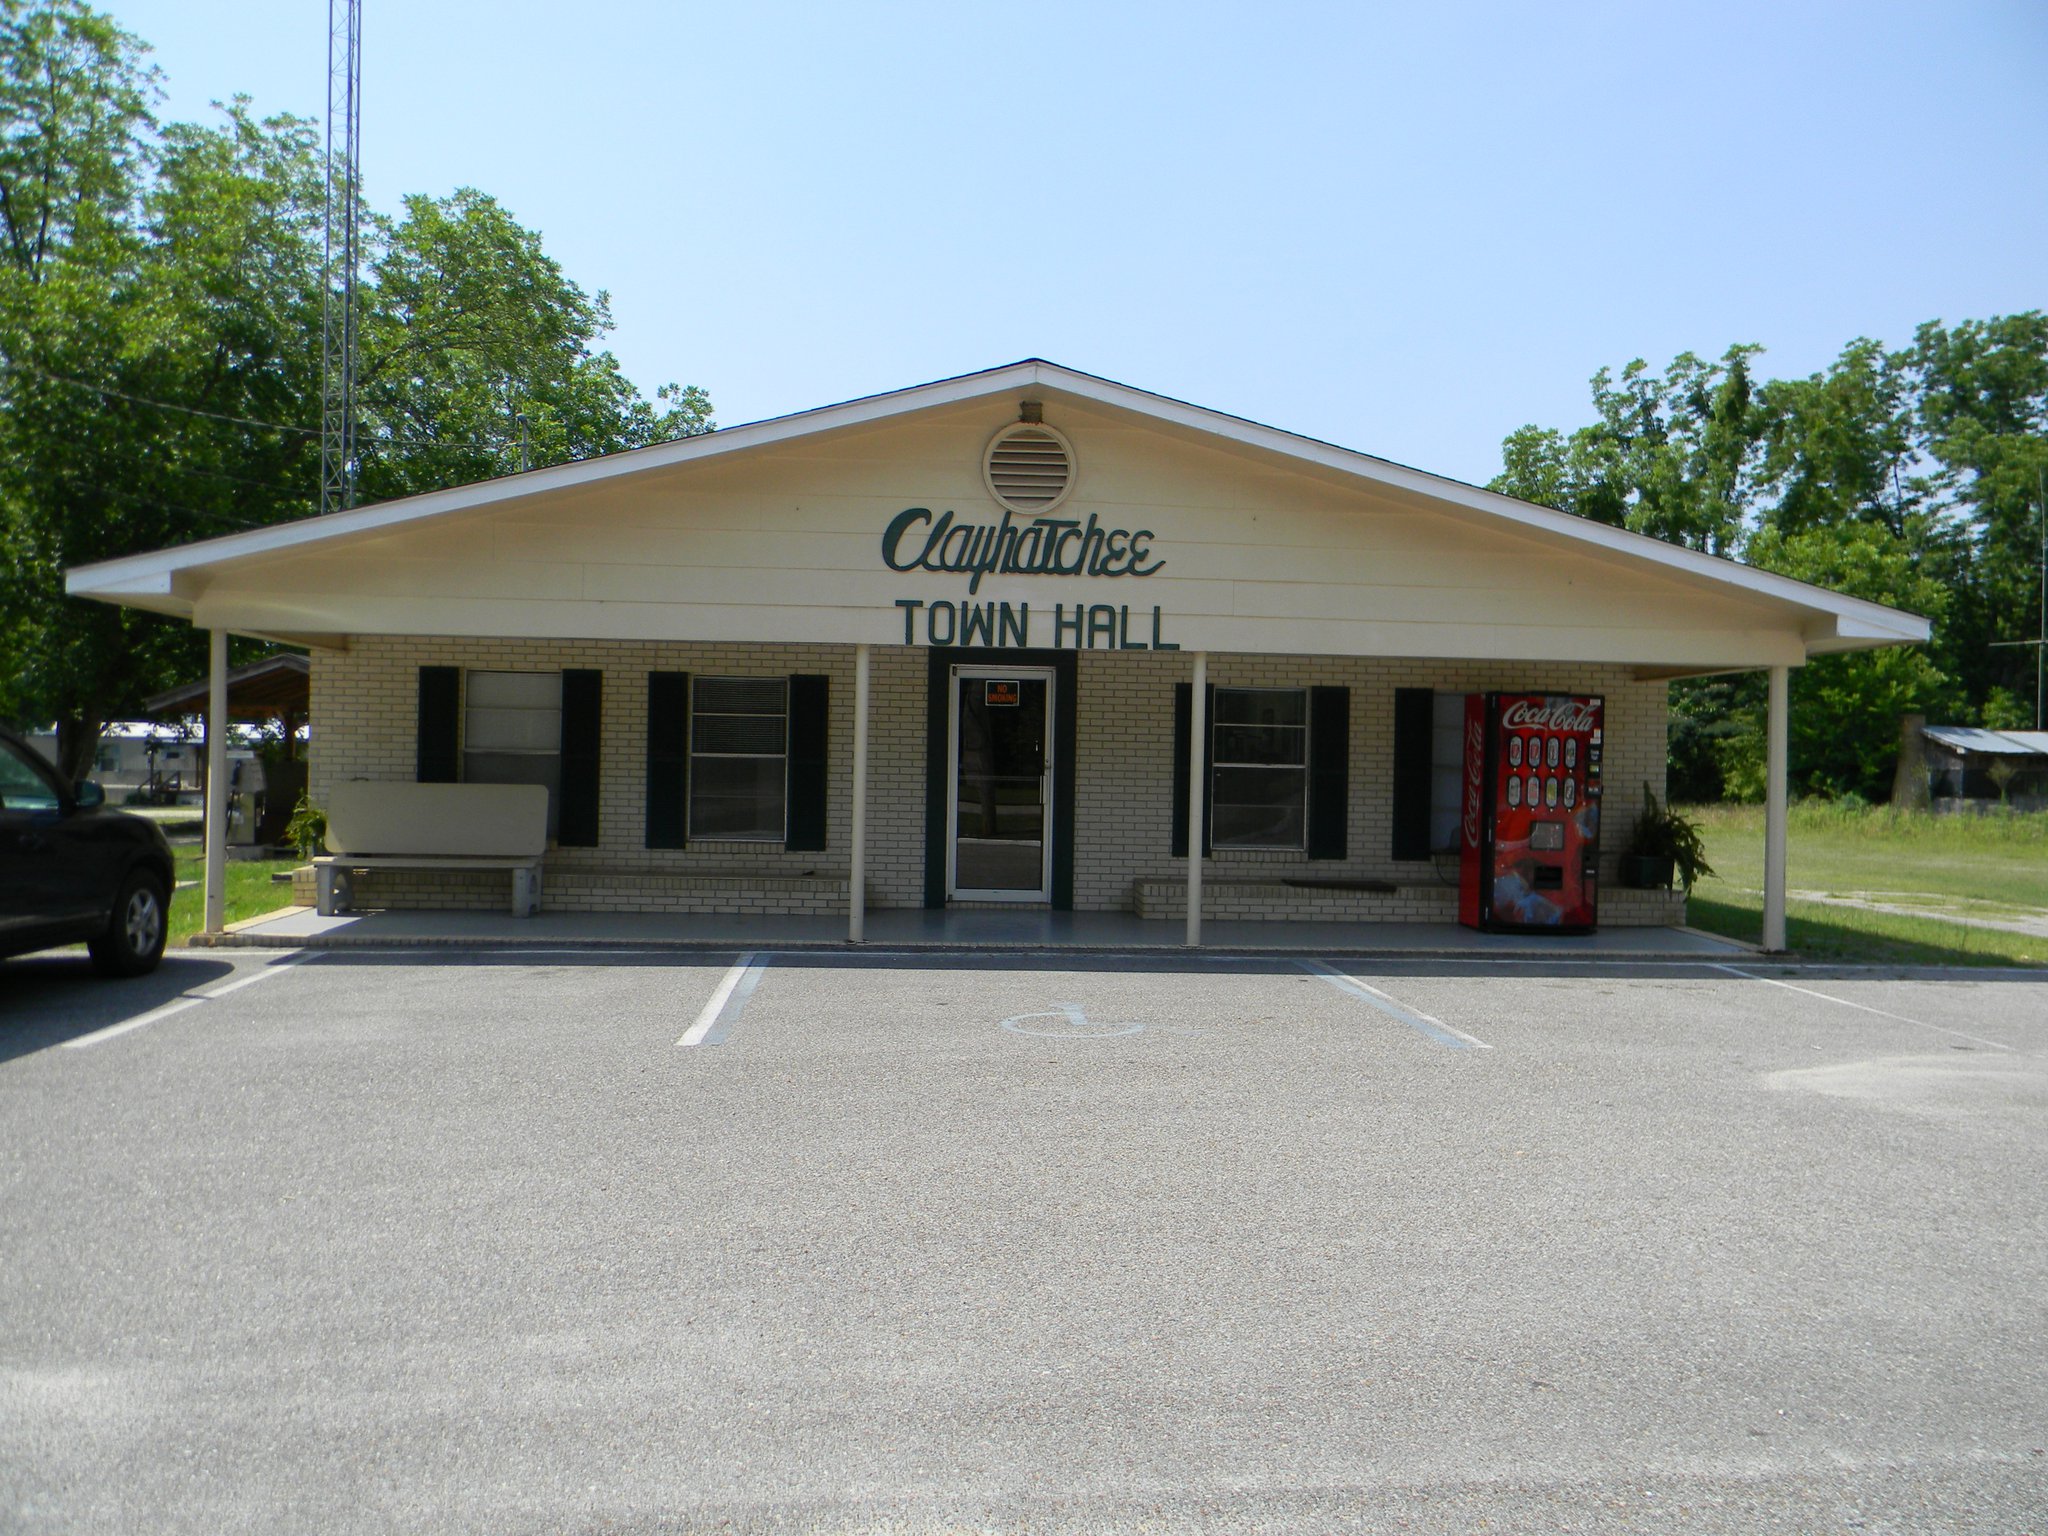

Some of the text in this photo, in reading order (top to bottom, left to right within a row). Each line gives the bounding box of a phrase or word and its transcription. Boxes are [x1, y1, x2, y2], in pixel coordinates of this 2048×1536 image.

[895, 599, 1181, 650] TOWN HALL
[997, 684, 1008, 694] NO
[988, 693, 1017, 703] SMOKING
